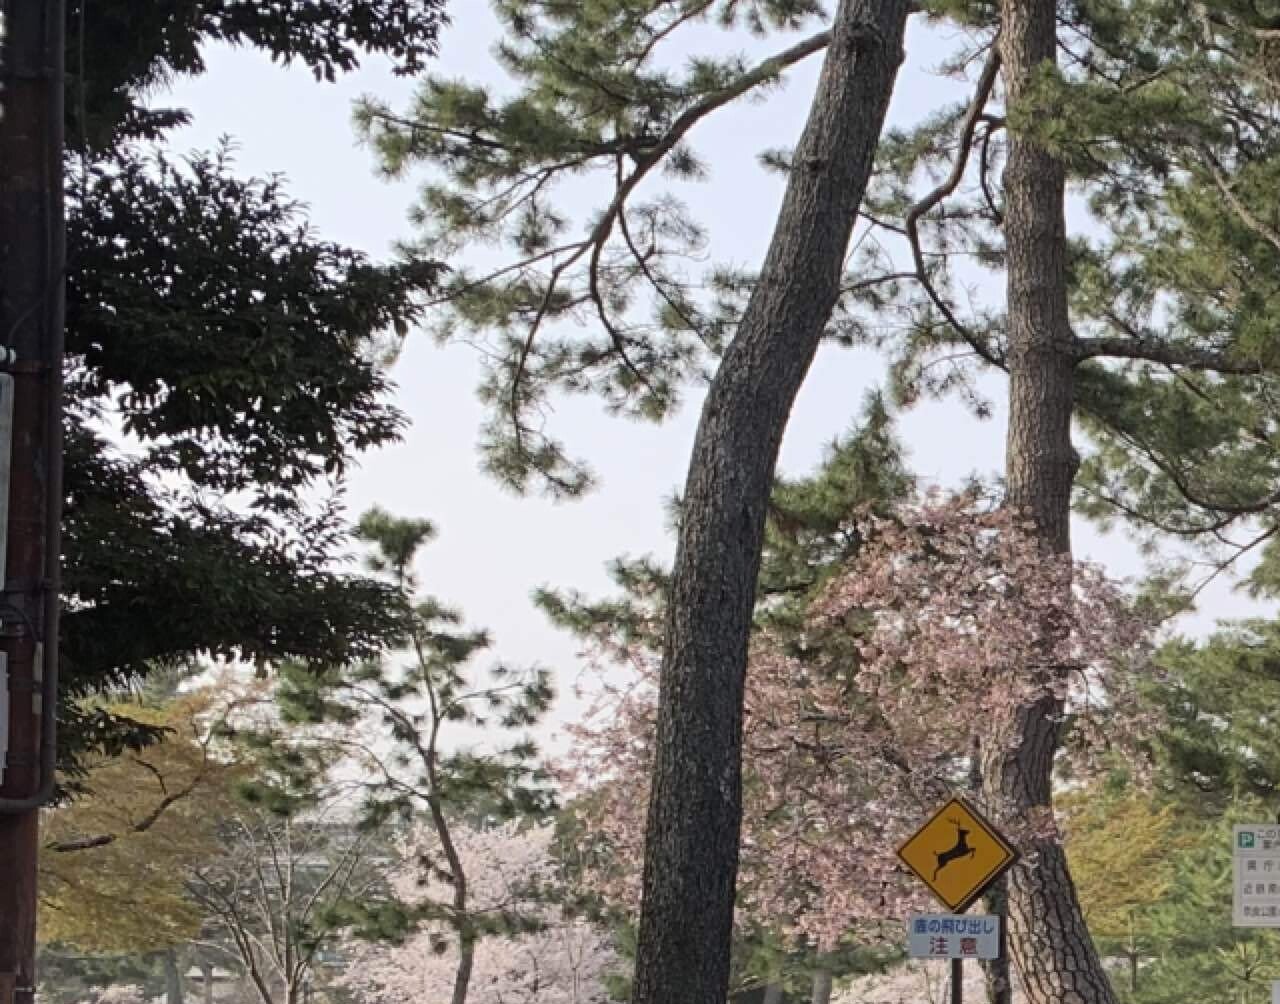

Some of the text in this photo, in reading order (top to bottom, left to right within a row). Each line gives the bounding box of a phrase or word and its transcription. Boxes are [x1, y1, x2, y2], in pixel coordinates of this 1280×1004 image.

[913, 918, 994, 935] 鹿の飛び出し
[929, 936, 976, 955] 注意
